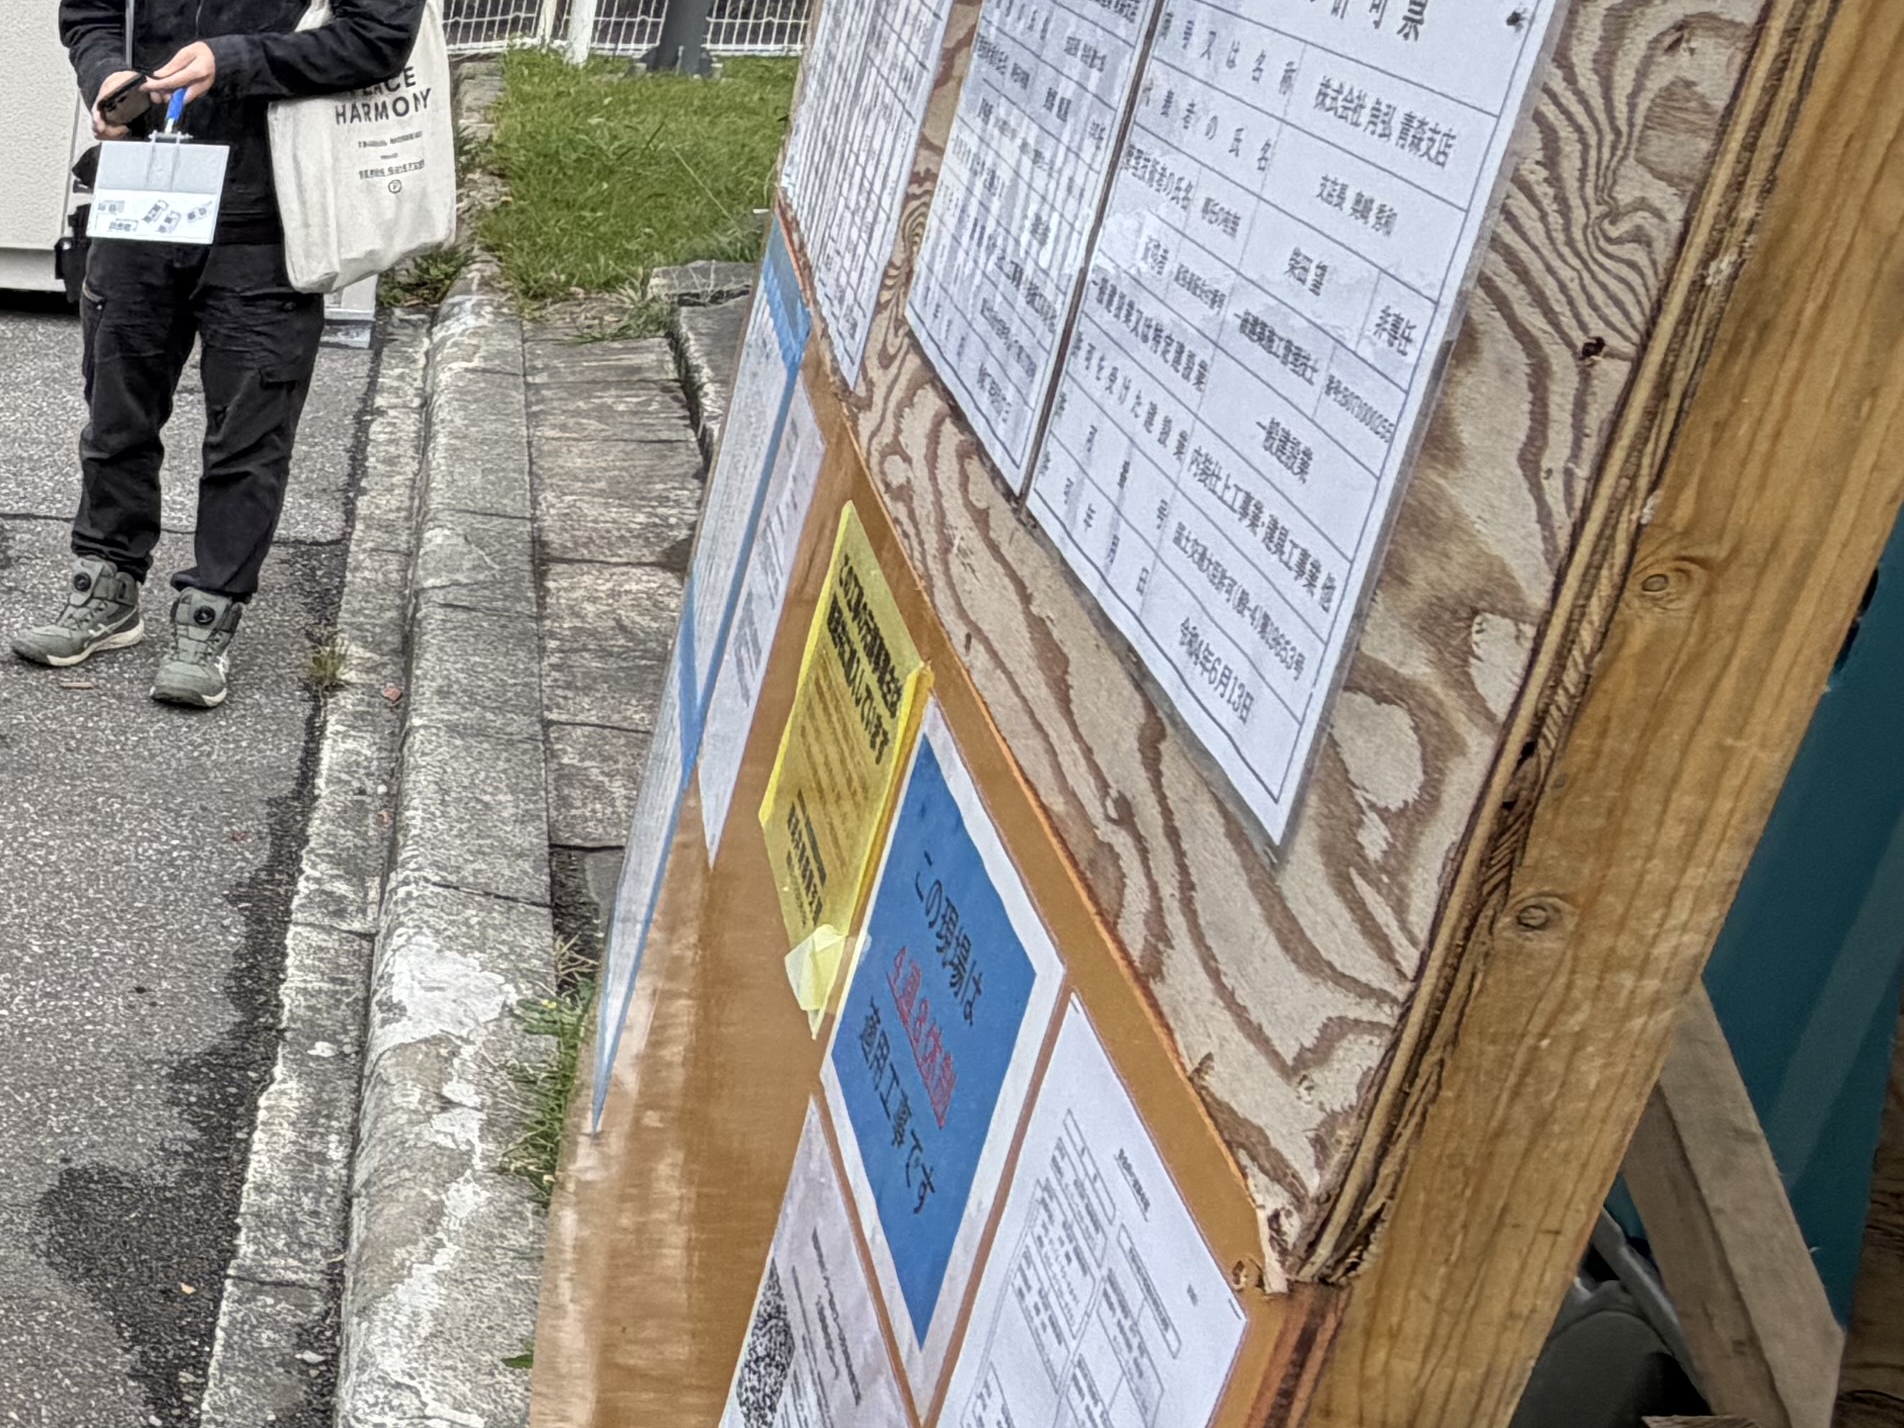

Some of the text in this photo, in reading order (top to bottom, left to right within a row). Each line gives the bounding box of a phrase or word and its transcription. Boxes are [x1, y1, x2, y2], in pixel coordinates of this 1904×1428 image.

[335, 87, 431, 125] HARMONY
[1313, 75, 1367, 128] 株式会社
[1395, 111, 1456, 168] 青森支店
[1373, 303, 1417, 357] 非専任
[1254, 414, 1313, 484] 一般建設業
[1178, 615, 1254, 725] 令和4年6月13日
[913, 844, 984, 1030] この現場は
[858, 993, 936, 1224] 適用工事です
